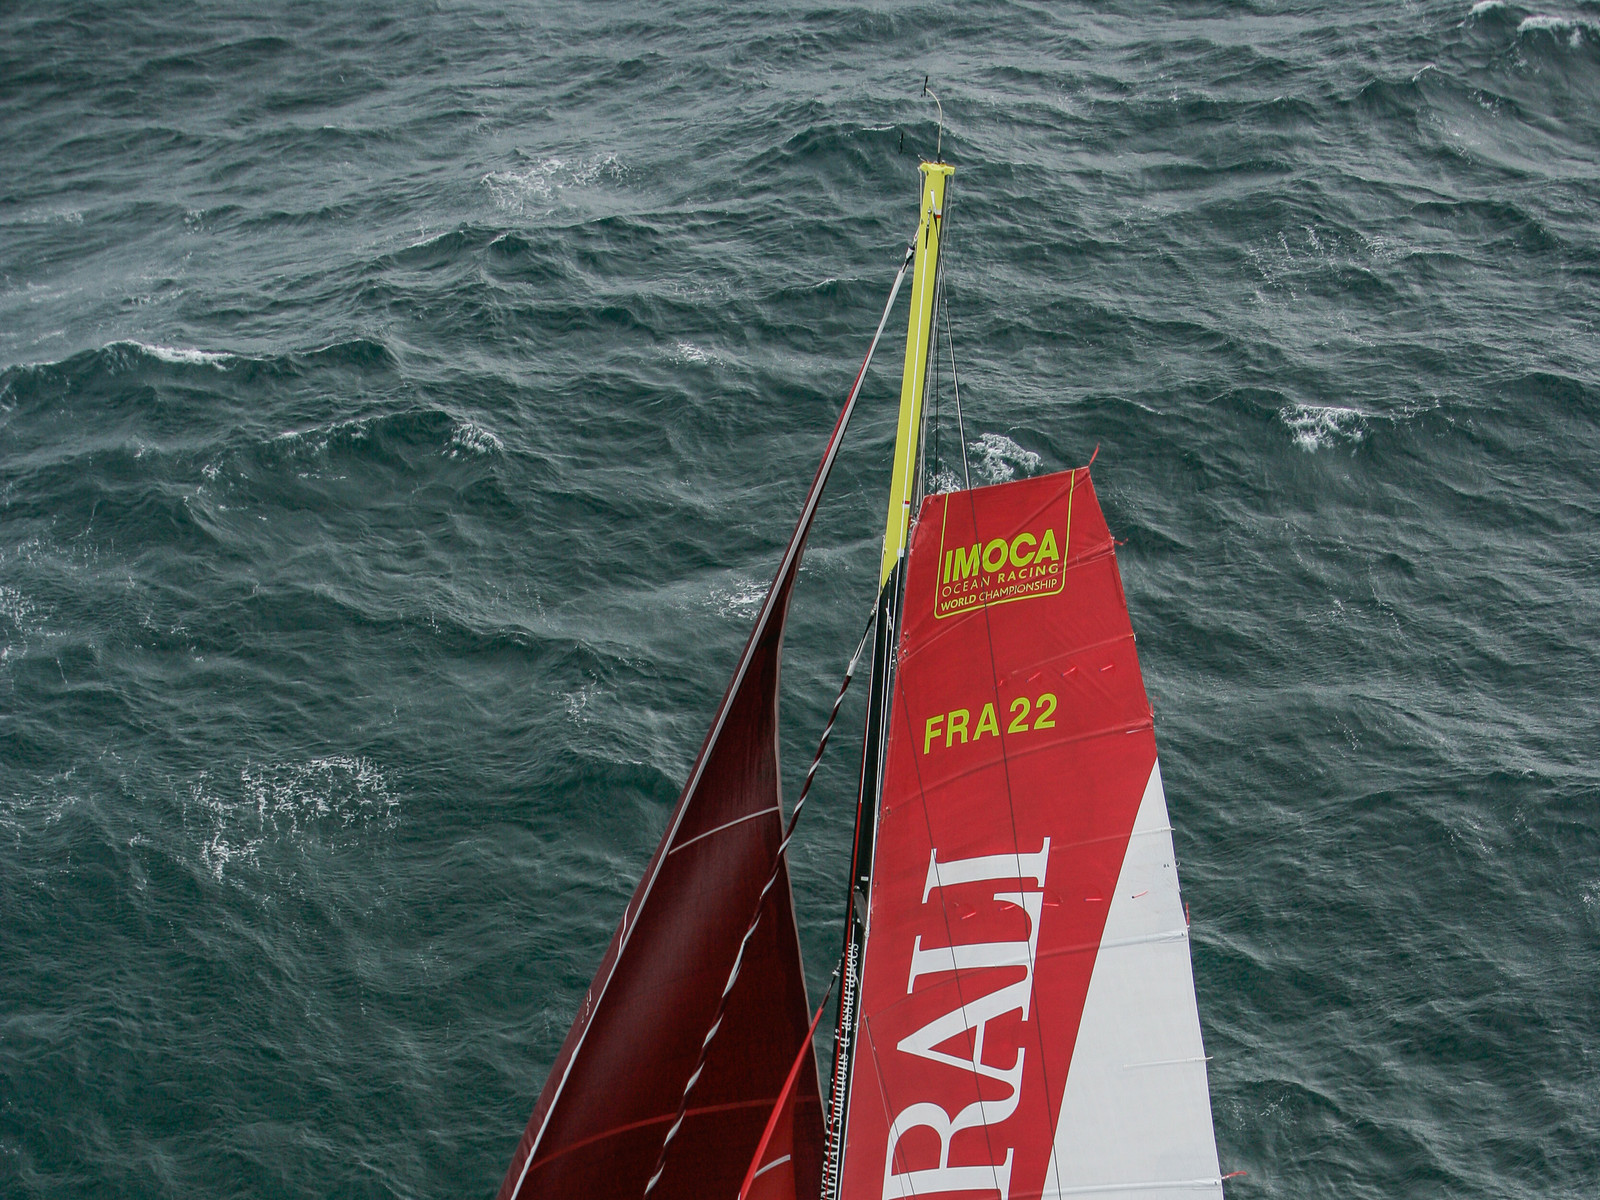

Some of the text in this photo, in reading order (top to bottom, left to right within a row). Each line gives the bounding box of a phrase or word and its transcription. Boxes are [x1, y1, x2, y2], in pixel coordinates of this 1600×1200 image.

[942, 528, 1060, 585] IMOCA
[940, 578, 1058, 612] WORLD CHAMPIONSHIP
[941, 563, 1059, 598] OCEAN RACING
[923, 692, 1058, 755] FRA 22
